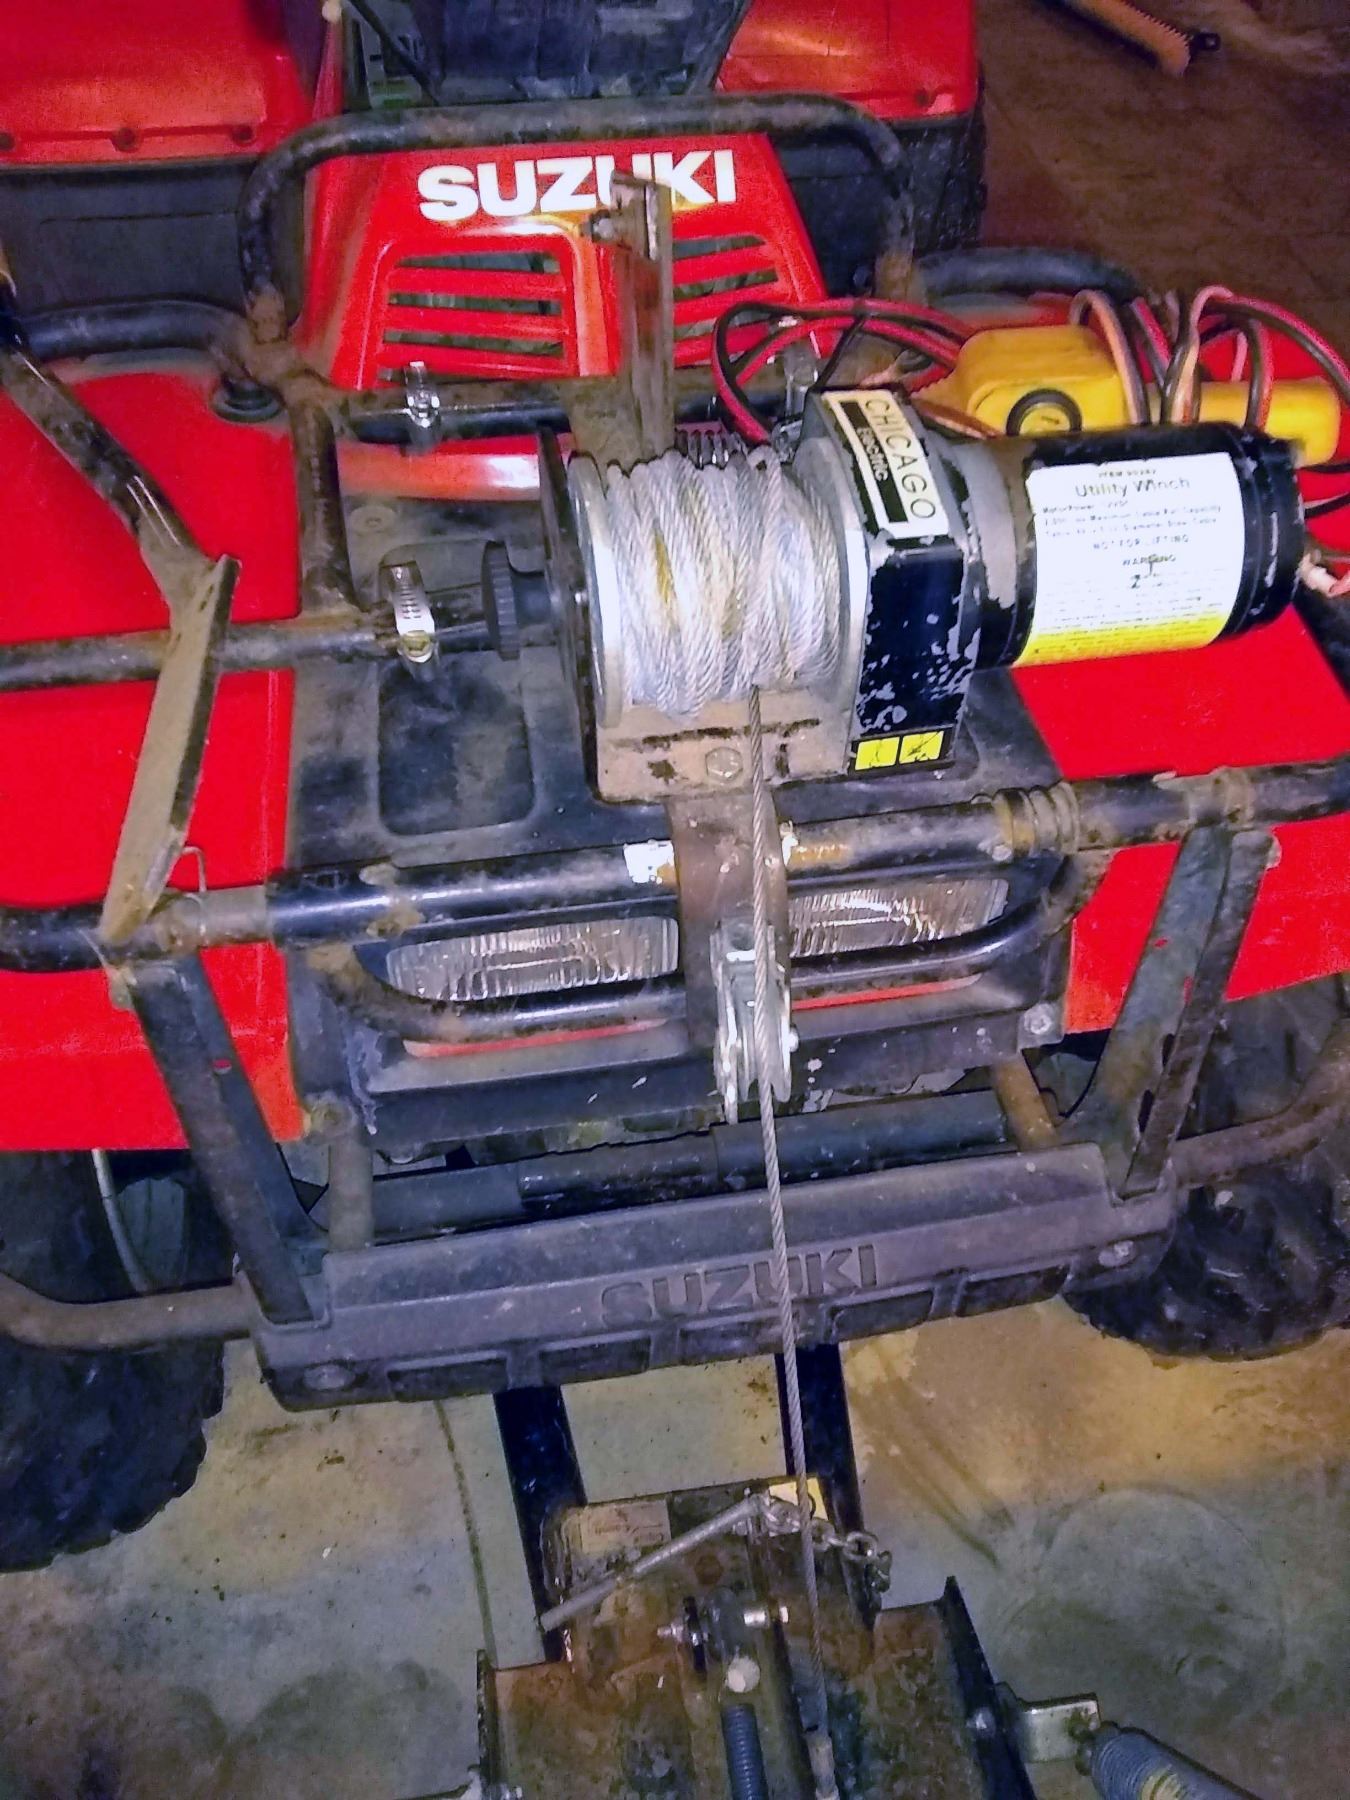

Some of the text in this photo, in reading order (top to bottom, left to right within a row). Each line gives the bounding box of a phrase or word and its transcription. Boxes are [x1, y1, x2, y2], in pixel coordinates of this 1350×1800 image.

[417, 149, 737, 223] SUZUKI
[865, 399, 936, 519] CHICAGO
[1075, 477, 1190, 498] Utility Winch
[601, 1243, 878, 1326] SUZUKI
